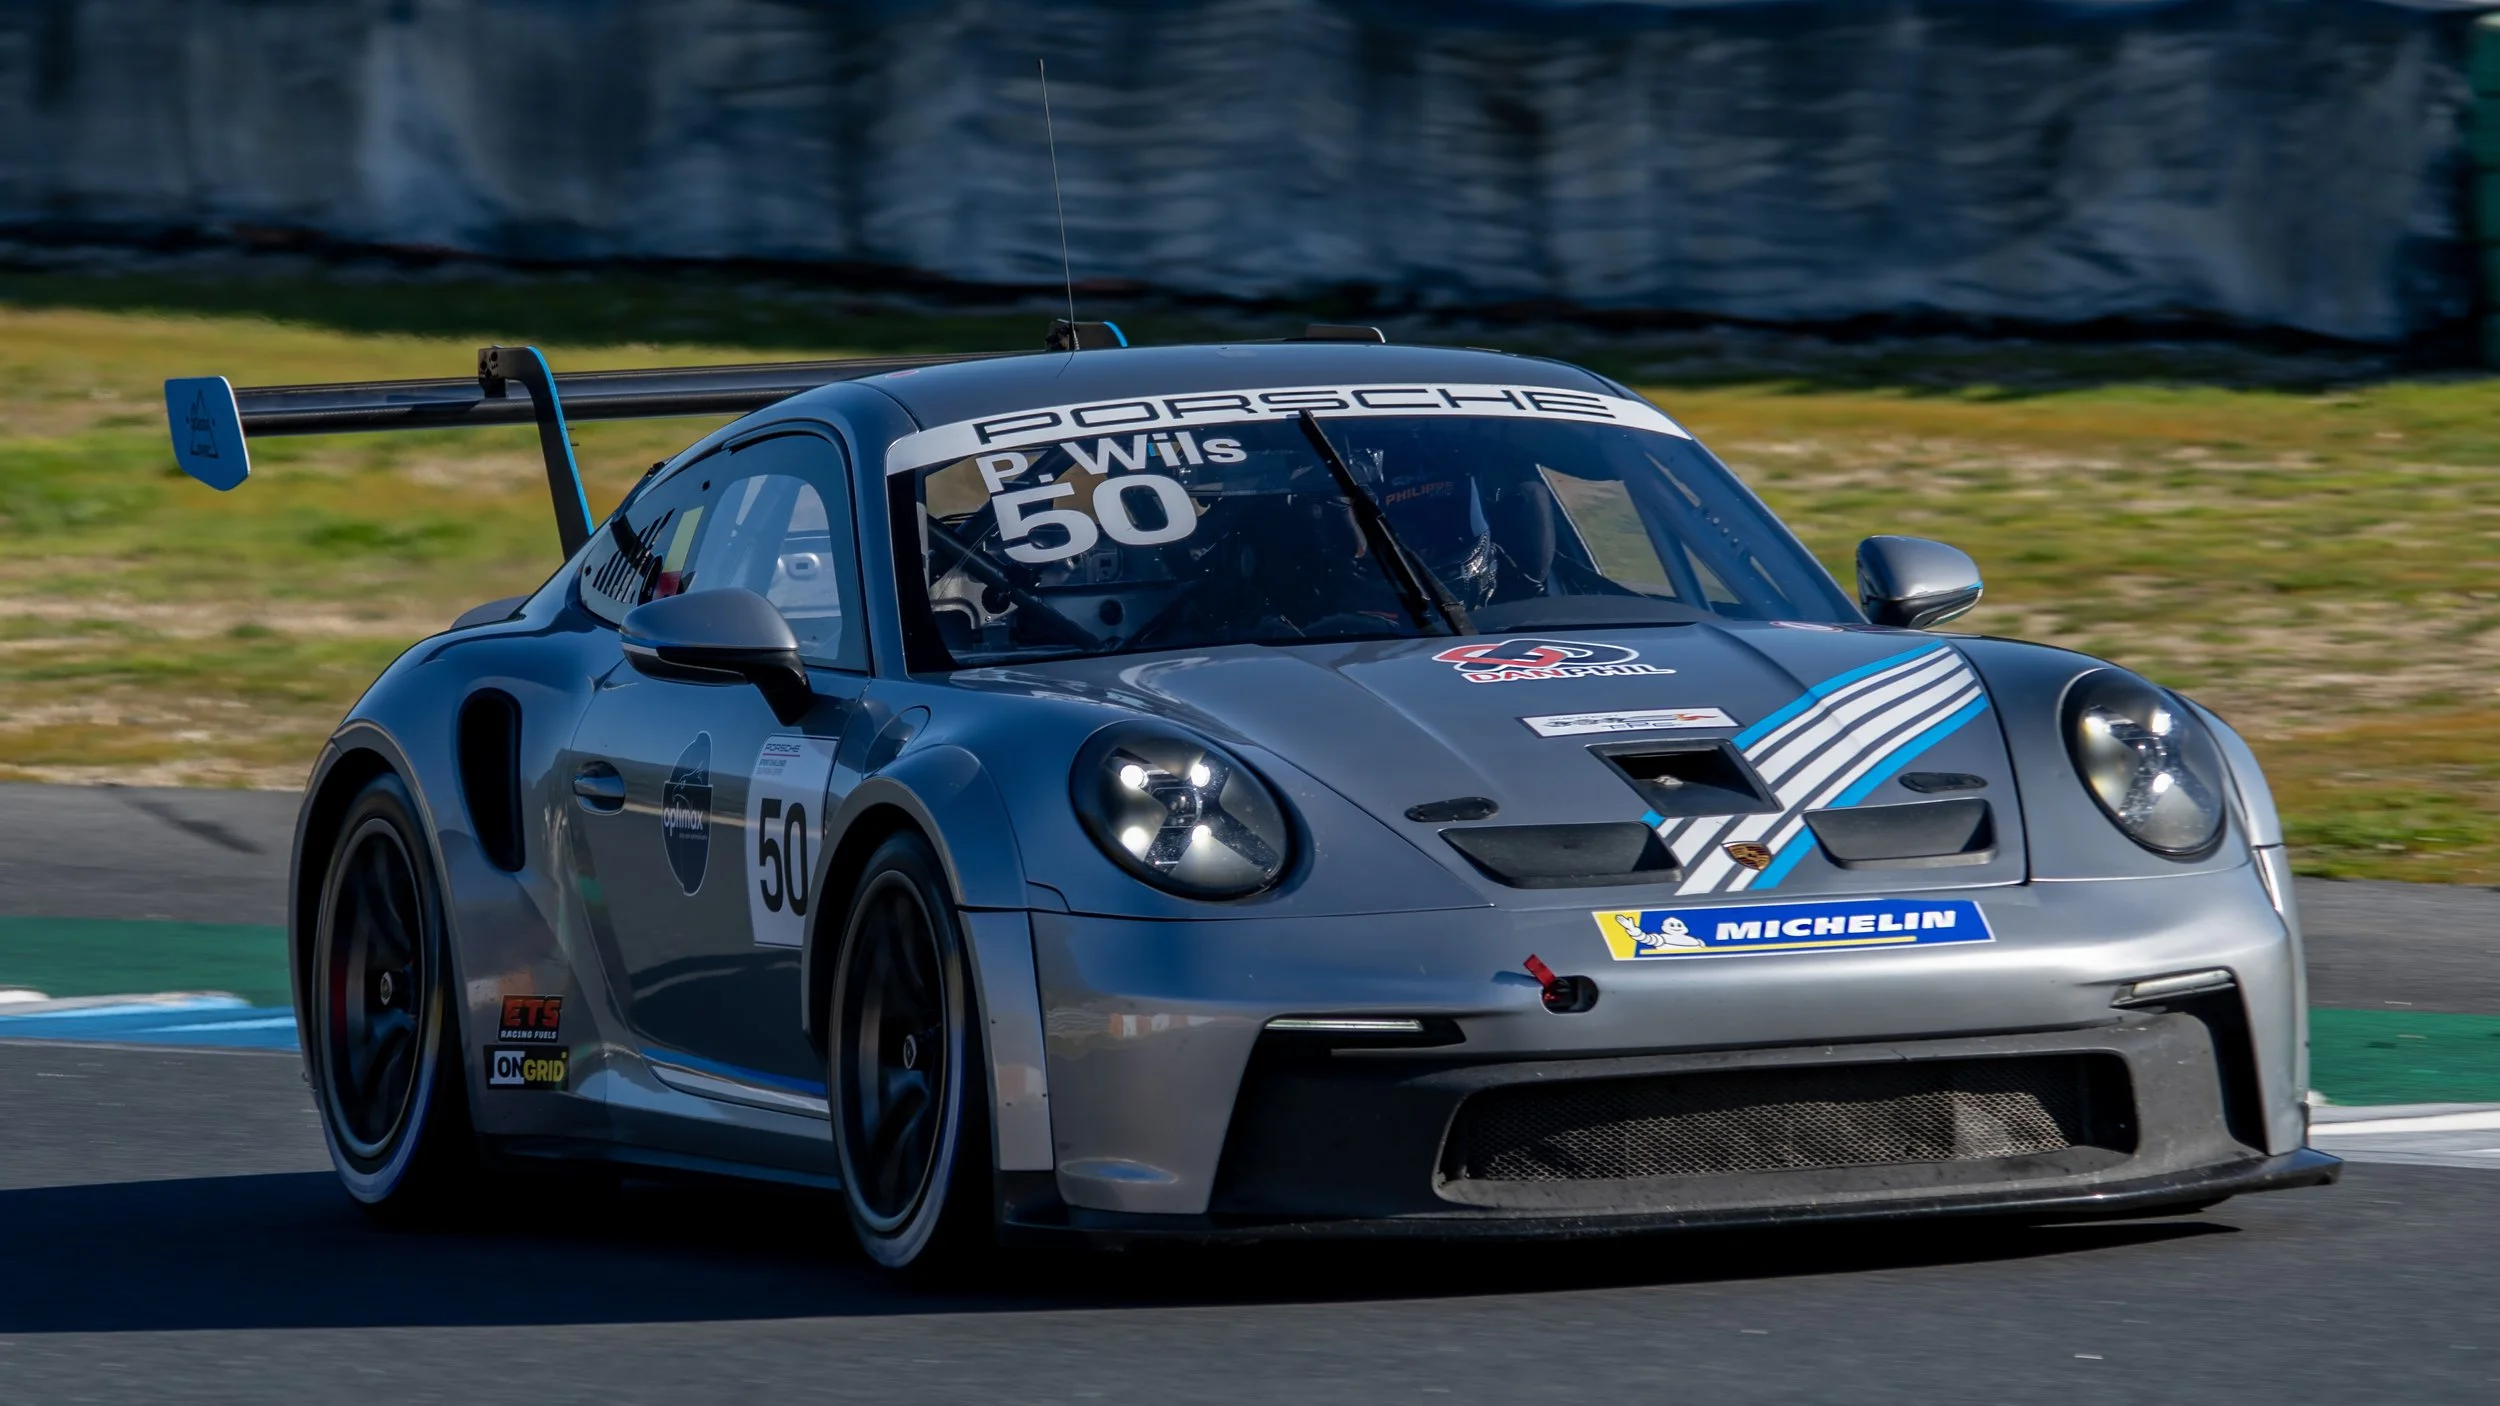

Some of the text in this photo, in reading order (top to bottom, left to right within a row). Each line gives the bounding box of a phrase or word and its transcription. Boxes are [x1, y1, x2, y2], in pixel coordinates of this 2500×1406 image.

[972, 389, 1616, 445] PORSCHE
[975, 431, 1247, 494] P. Wils
[992, 474, 1197, 564] 50
[1463, 663, 1672, 683] DANPHIL
[663, 802, 704, 837] optimax
[759, 797, 808, 917] 50
[1716, 910, 1957, 941] MICHELIN
[504, 999, 560, 1027] ETS
[500, 1030, 557, 1040] RACING FUELS
